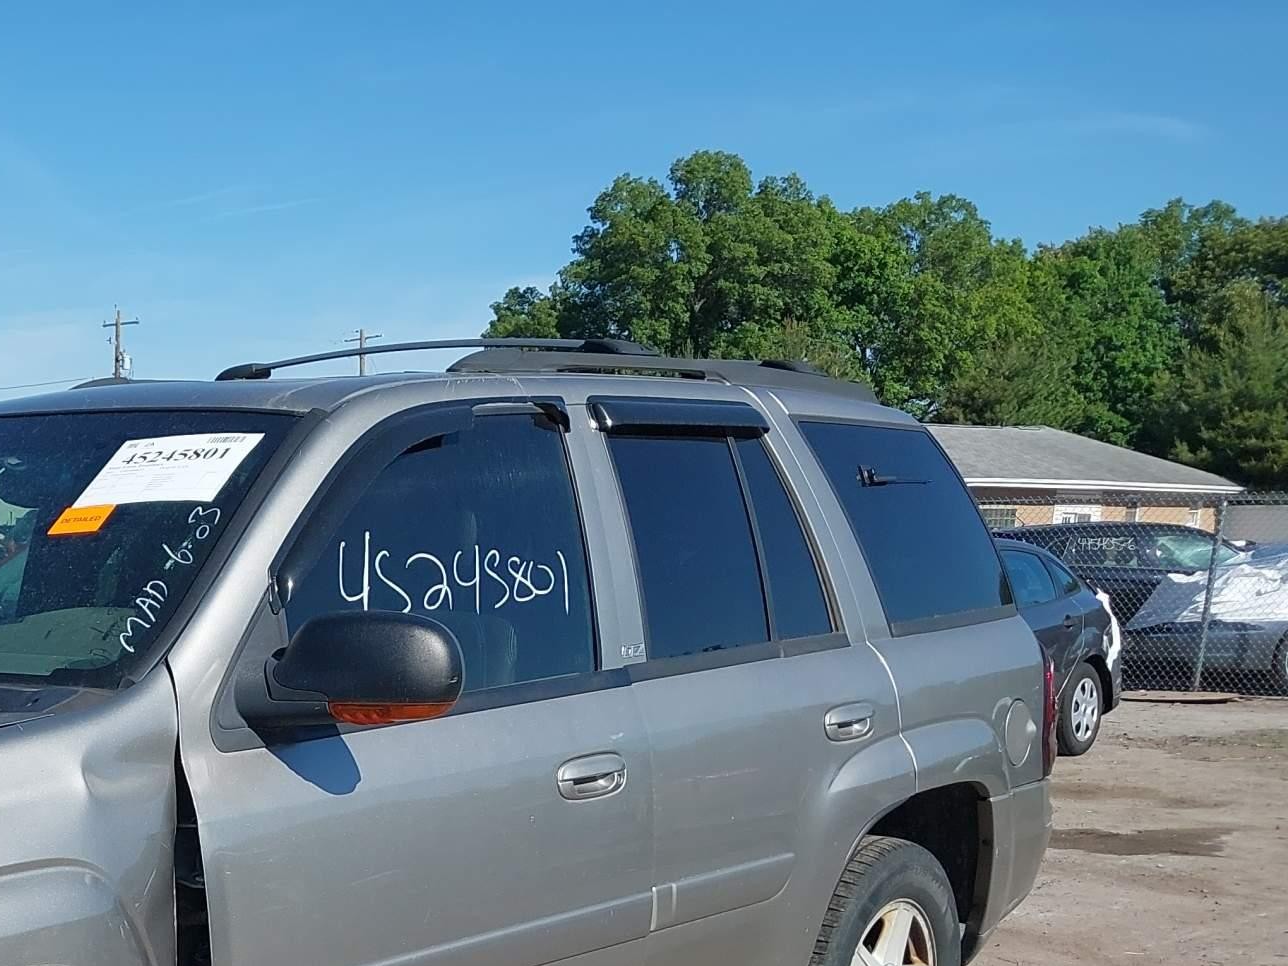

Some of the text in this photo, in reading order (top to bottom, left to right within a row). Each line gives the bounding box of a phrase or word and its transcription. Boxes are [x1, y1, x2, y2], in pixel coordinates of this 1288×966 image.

[122, 447, 232, 466] 45245801
[339, 531, 570, 615] 45245801
[120, 580, 168, 653] MAD
